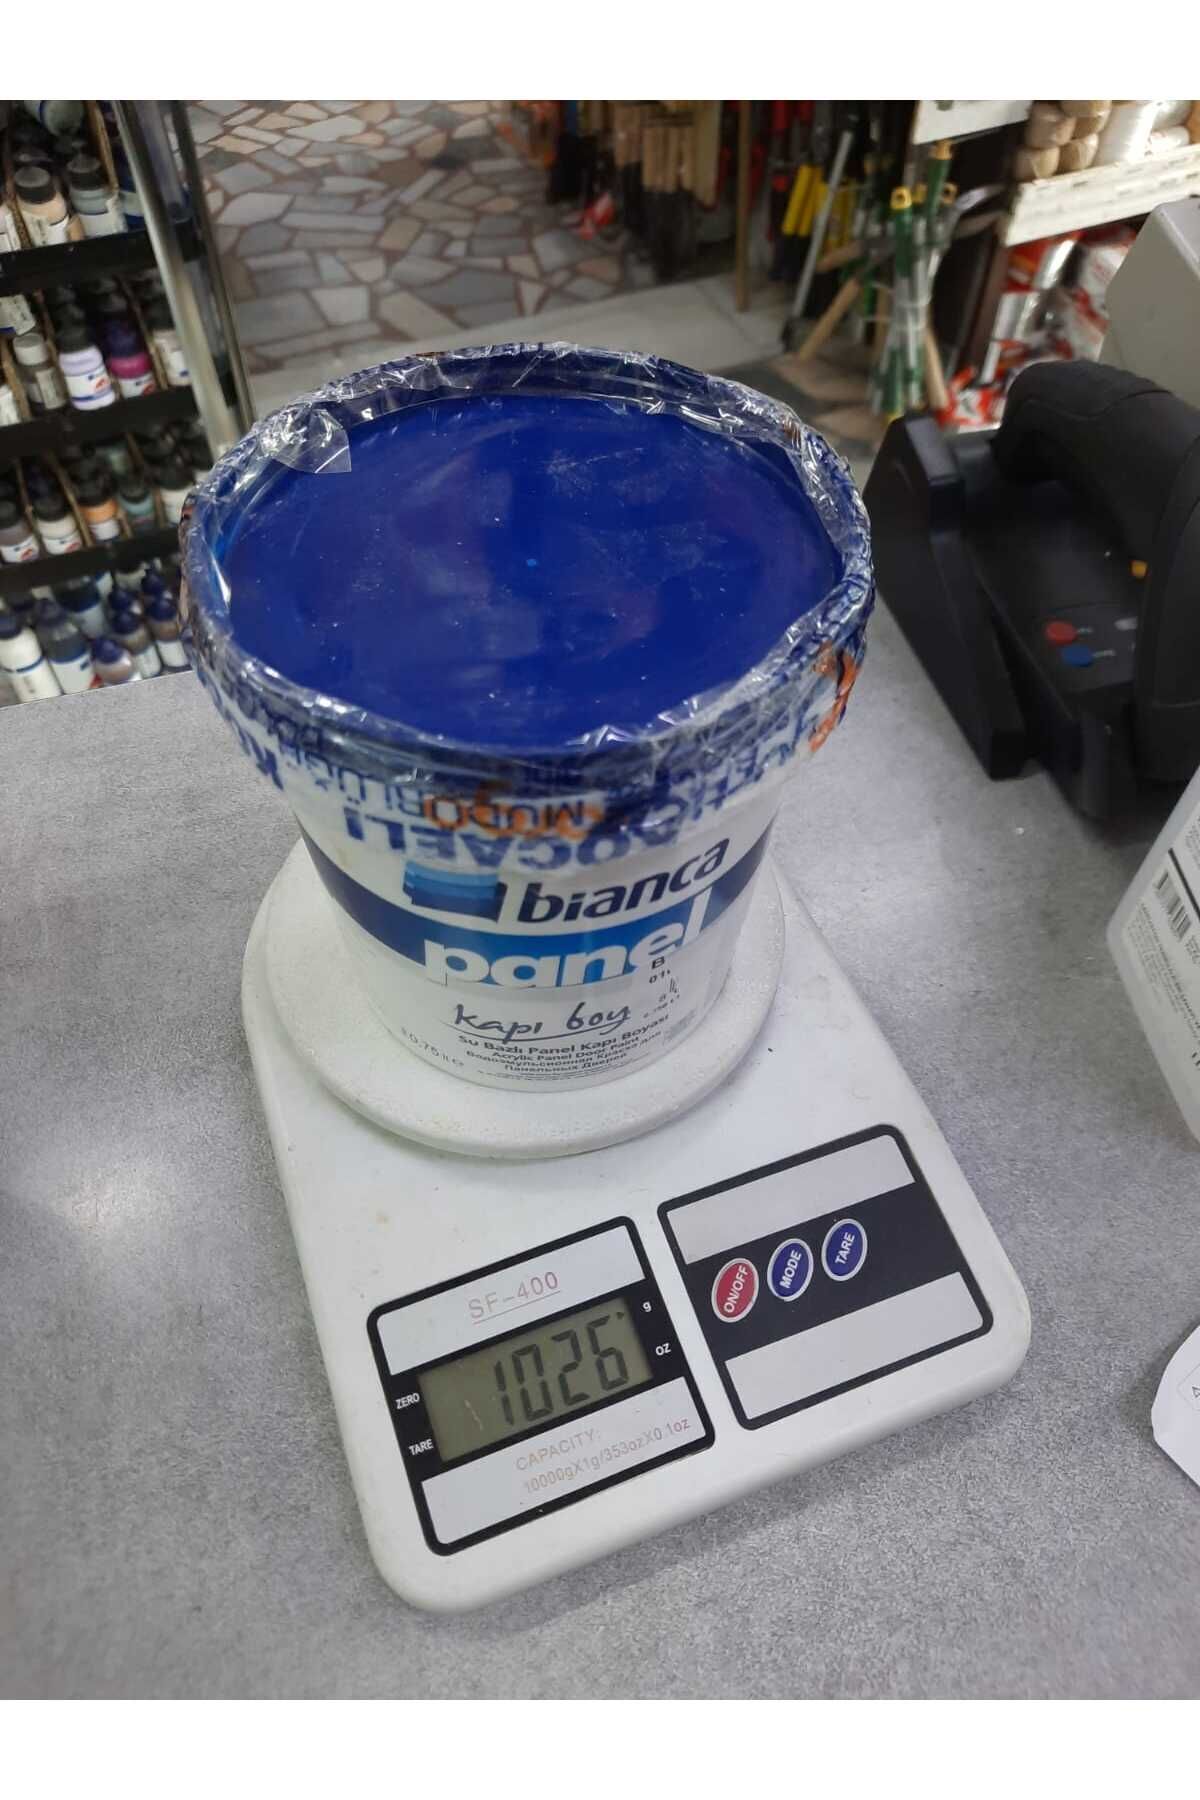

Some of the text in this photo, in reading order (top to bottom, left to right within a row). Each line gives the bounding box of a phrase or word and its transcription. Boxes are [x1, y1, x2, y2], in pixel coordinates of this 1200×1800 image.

[517, 838, 730, 924] bianca
[424, 886, 713, 988] panel
[459, 1035, 478, 1046] Su
[528, 1045, 575, 1054] Panel
[581, 1038, 617, 1050] Kapı
[537, 1053, 572, 1061] Panel
[575, 1048, 606, 1058] Door
[834, 1231, 856, 1265] TARE
[779, 1249, 803, 1289] MODE
[467, 1271, 560, 1320] SF-400
[642, 1301, 652, 1313] g
[723, 1264, 750, 1313] ON/OFF
[492, 1314, 630, 1427] 1026
[395, 1392, 421, 1410] ZERO
[408, 1438, 435, 1456] TARE
